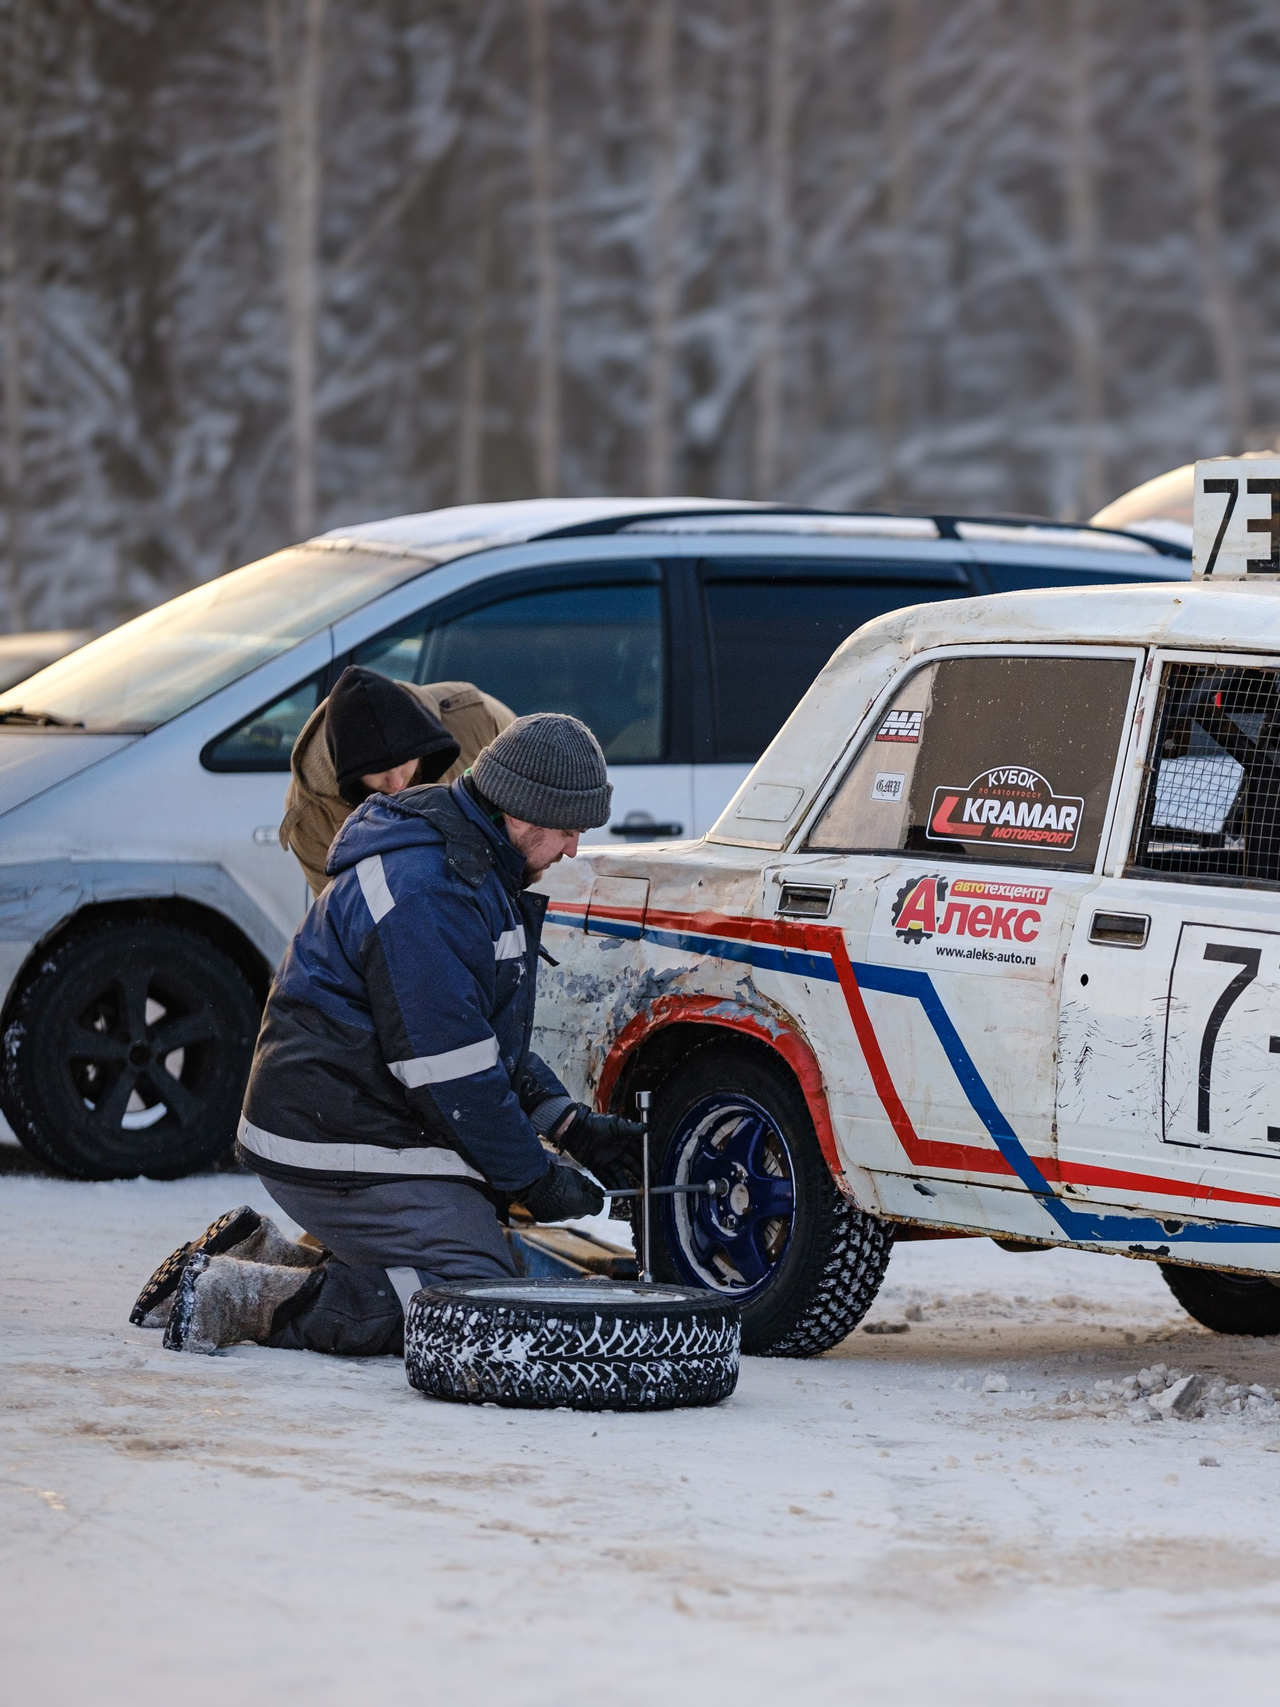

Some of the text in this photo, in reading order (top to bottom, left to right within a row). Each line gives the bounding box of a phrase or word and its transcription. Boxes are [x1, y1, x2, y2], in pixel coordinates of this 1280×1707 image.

[988, 769, 1039, 791] КУБОК
[978, 787, 1042, 799] ПО АВТОКРОССУ
[962, 797, 1078, 831] KRAMAR
[991, 826, 1073, 844] MOTORSPORT
[954, 880, 1046, 902] автотехцентр
[895, 878, 1042, 942] Алекс
[936, 946, 1037, 965] www.aleks-auto.ru
